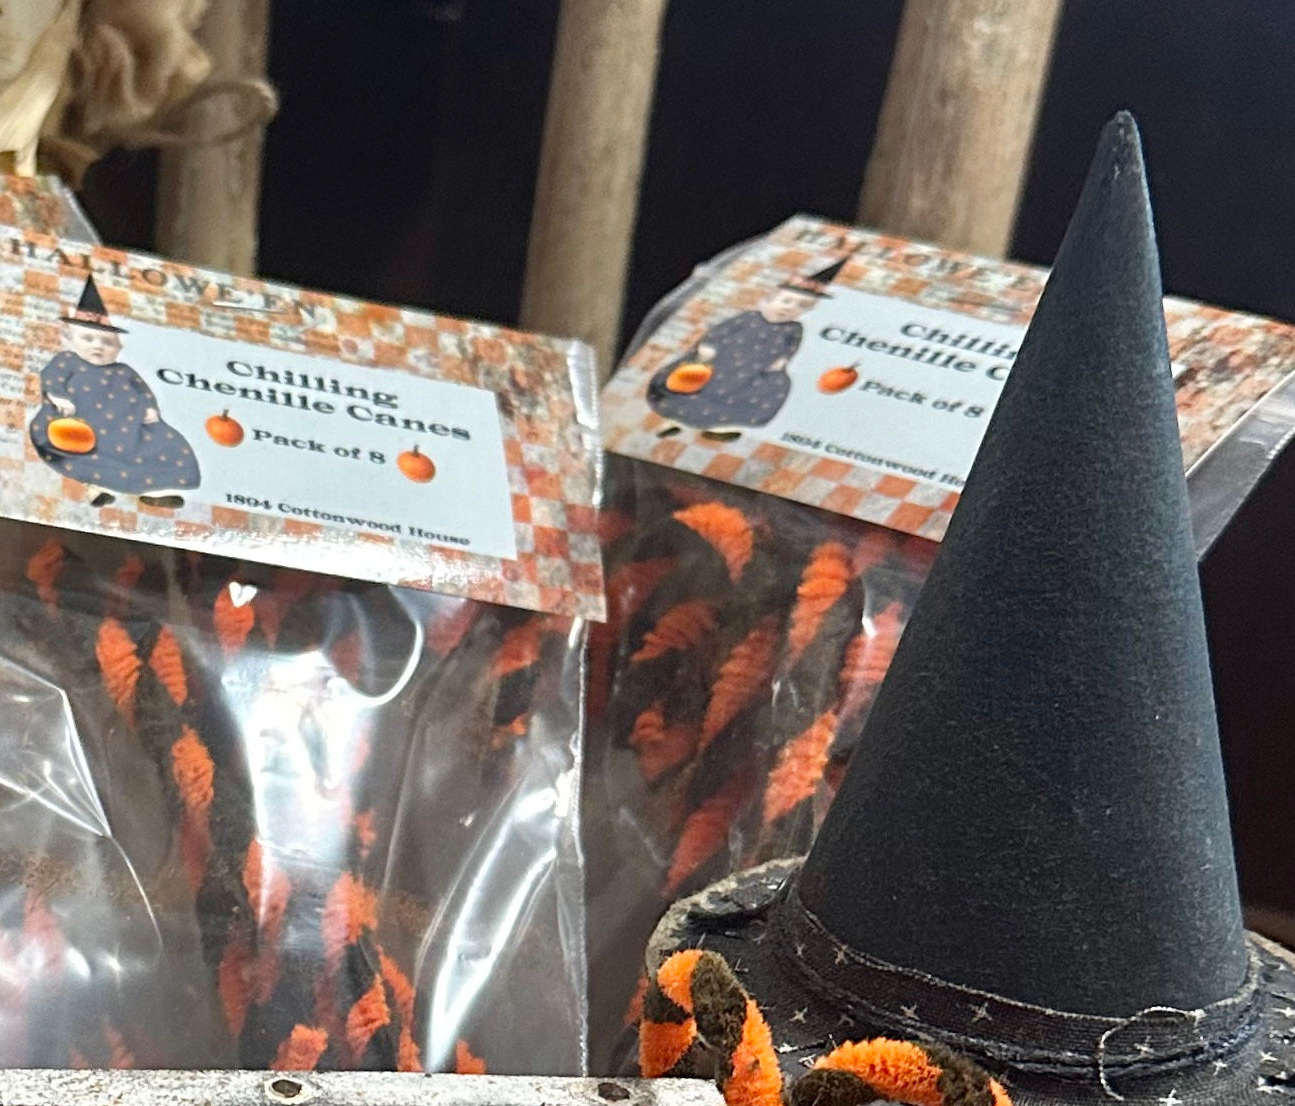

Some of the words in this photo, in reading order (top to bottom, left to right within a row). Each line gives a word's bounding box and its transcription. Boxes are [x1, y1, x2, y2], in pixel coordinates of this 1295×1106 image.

[818, 325, 978, 374] Chenille
[900, 320, 1018, 360] Chilli
[156, 367, 336, 415] Chenille
[346, 404, 472, 441] Canes
[226, 360, 399, 409] Chilling
[858, 379, 928, 405] Pack
[931, 399, 962, 413] of
[963, 405, 985, 419] 8
[252, 428, 326, 453] Pack
[334, 446, 360, 460] of
[369, 450, 387, 465] 8
[225, 492, 271, 511] 1894
[277, 502, 402, 534] Cottonwood
[408, 525, 471, 546] House
